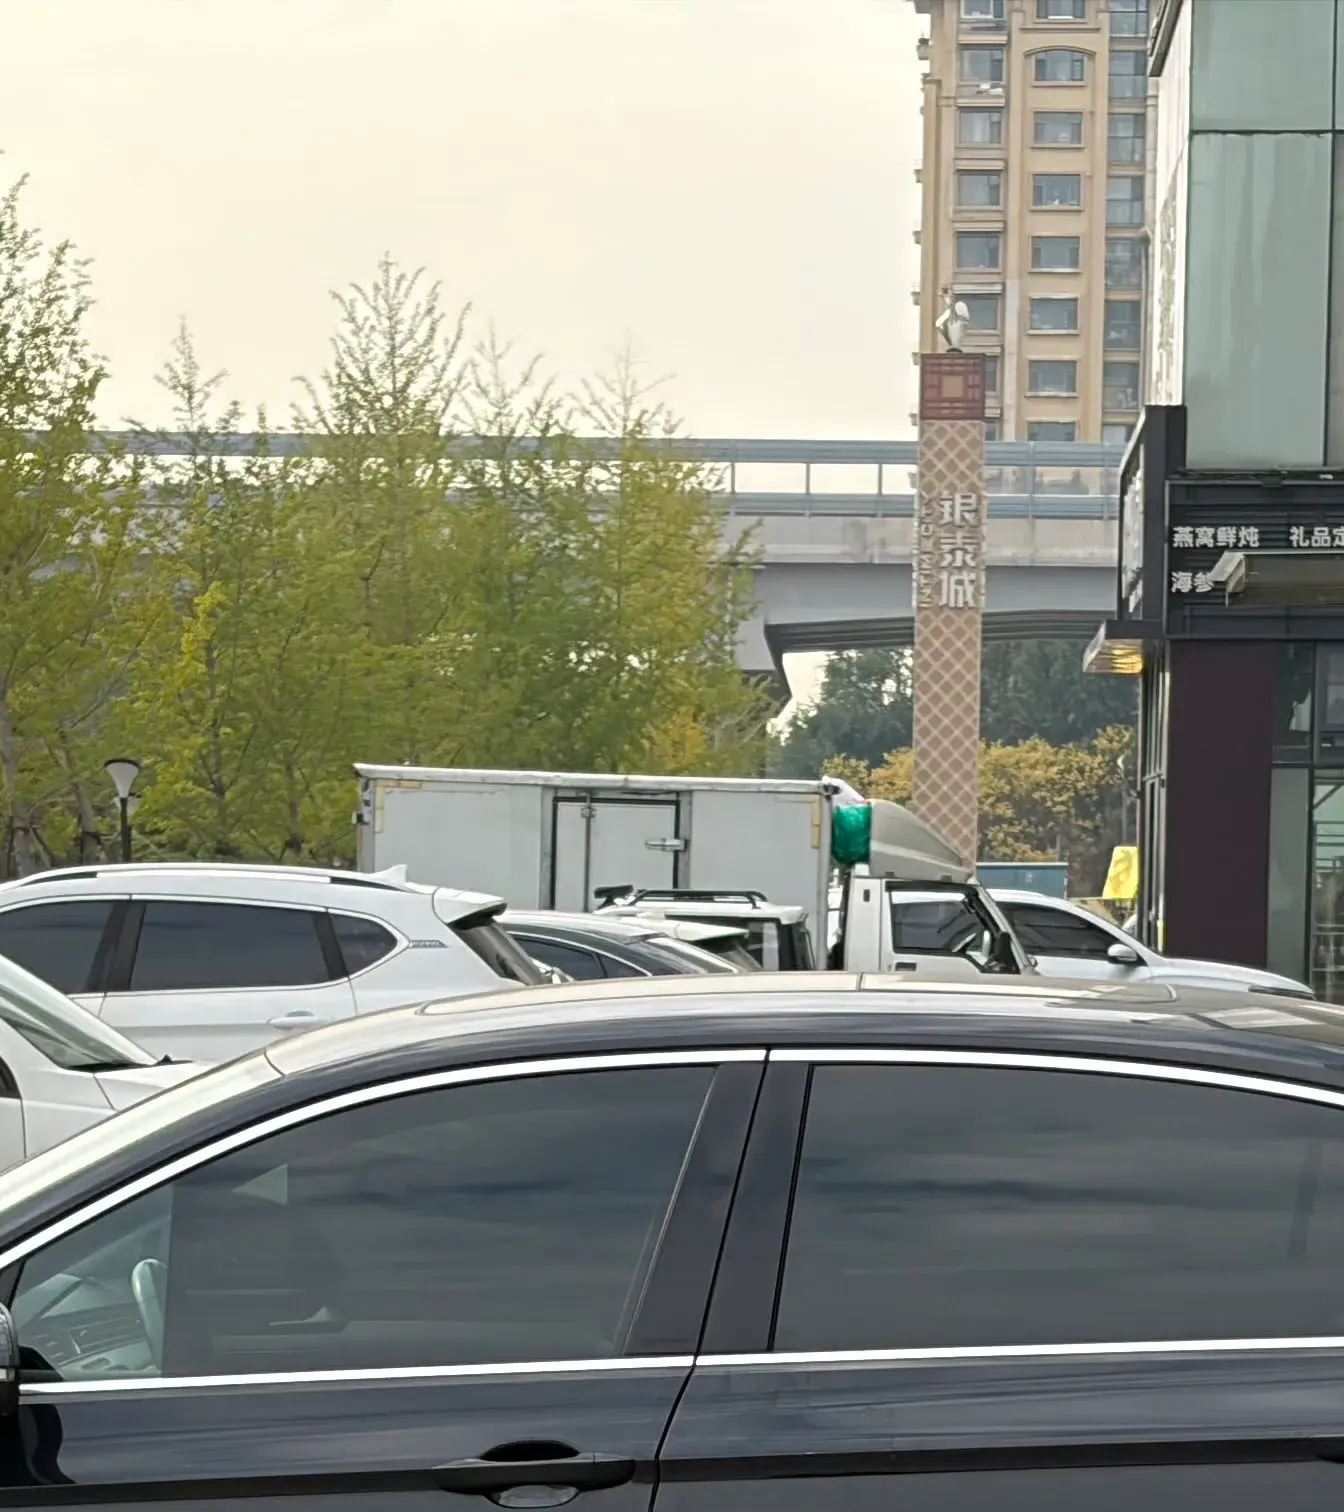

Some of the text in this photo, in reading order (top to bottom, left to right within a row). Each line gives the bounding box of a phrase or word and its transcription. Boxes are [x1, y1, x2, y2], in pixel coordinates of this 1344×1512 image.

[938, 491, 977, 609] 银泰城
[1172, 526, 1260, 548] 燕窝鲜炖
